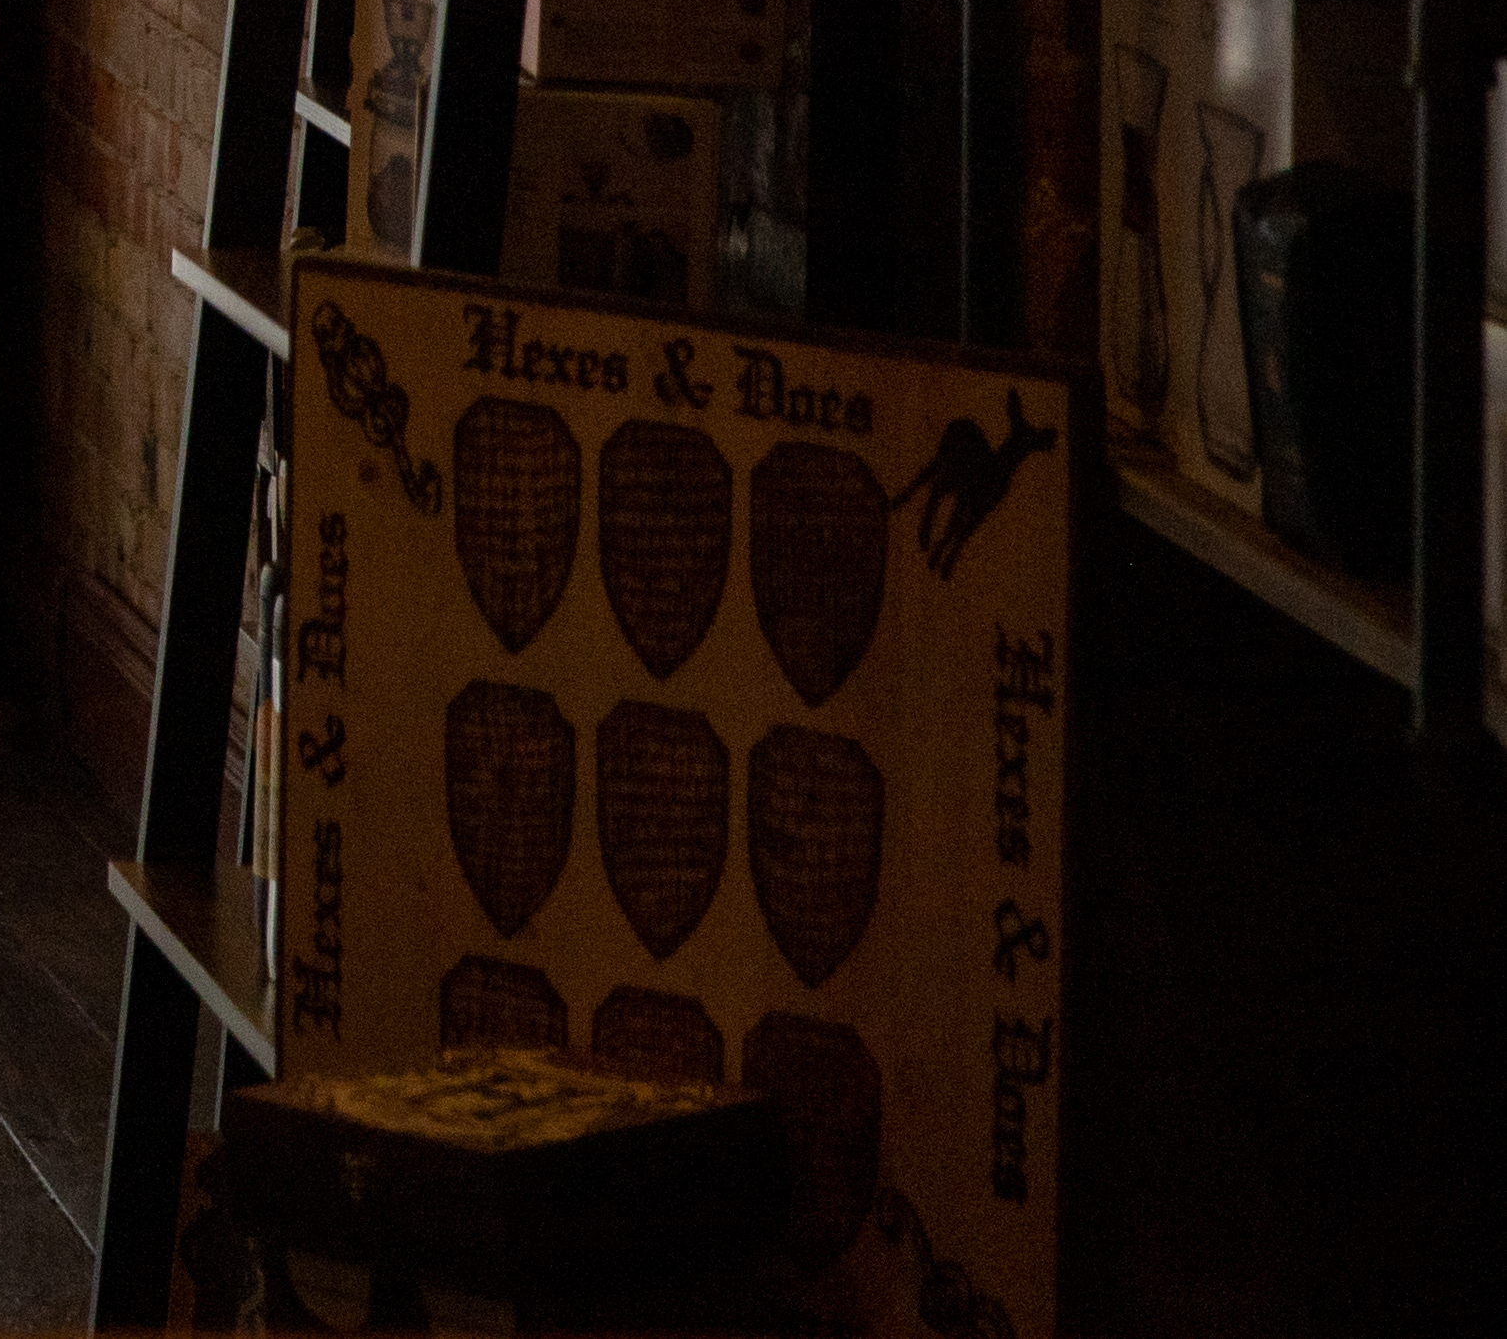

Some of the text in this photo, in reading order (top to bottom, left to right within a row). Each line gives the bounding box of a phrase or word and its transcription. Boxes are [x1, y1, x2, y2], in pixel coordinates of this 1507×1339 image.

[462, 303, 630, 394] Hexes
[653, 338, 714, 412] &
[299, 715, 349, 788] &
[992, 900, 1050, 983] &
